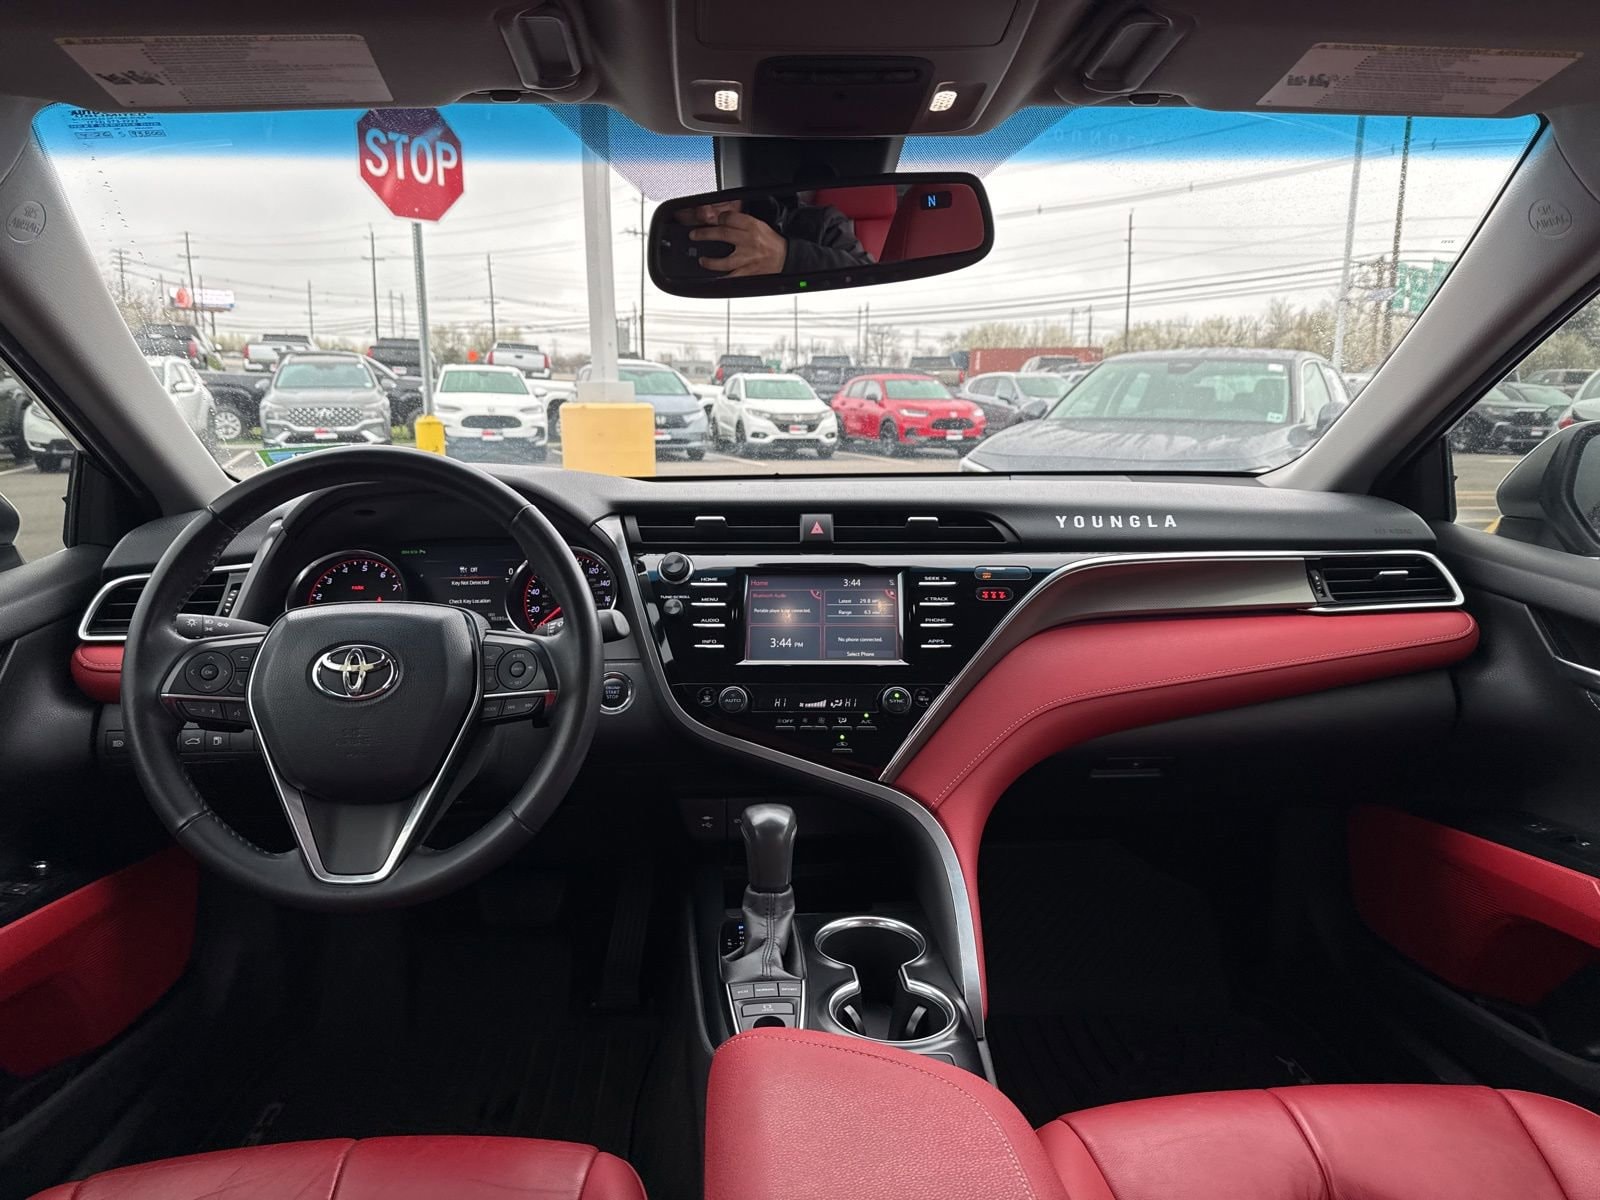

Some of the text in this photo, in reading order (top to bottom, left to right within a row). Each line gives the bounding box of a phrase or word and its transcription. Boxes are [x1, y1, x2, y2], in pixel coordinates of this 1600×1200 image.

[365, 127, 458, 187] STOP
[927, 194, 936, 207] N
[1055, 514, 1177, 529] YOUNGLA
[380, 571, 386, 579] 6
[588, 567, 600, 575] 120
[843, 578, 861, 587] 3:44
[392, 584, 399, 592] 7
[531, 588, 540, 596] 40
[315, 593, 323, 601] 2
[770, 637, 792, 648] 3:44
